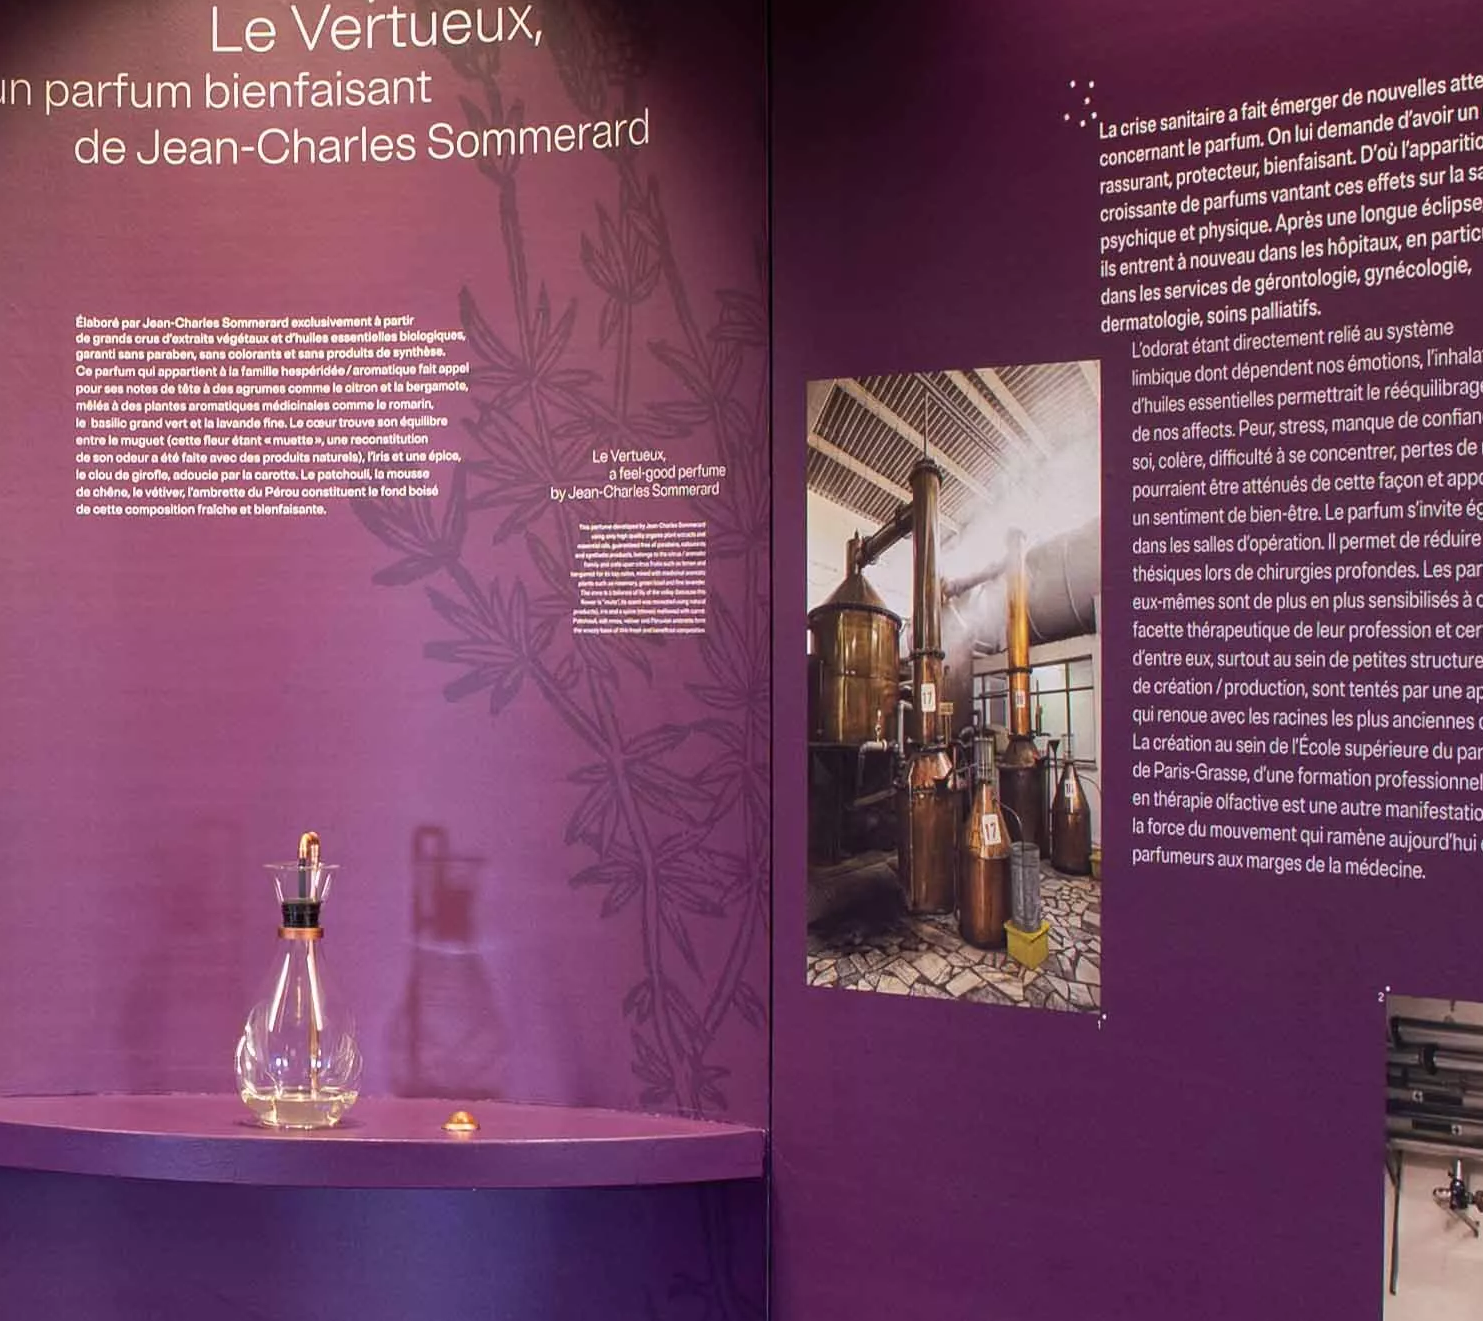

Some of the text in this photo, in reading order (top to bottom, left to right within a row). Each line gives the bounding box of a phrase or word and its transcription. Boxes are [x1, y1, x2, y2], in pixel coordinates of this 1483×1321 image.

[212, 2, 542, 52] Le Vertueux,
[46, 72, 191, 115] parfum
[206, 70, 432, 109] bienfaisant
[75, 107, 649, 165] de Jean-Charles Sommerard
[76, 314, 415, 330] Élaboré par Jean-Charles Sommerard exclusivement à partir
[592, 449, 666, 463] Le Vertueux,
[609, 464, 726, 483] a feel-good perfume
[550, 482, 720, 503] by Jean-Charles Sommerard
[923, 691, 934, 706] 17
[984, 821, 998, 841] 17
[1132, 846, 1426, 879] parfumeurs aux marges de la médecine.
[1377, 991, 1385, 1002] 2
